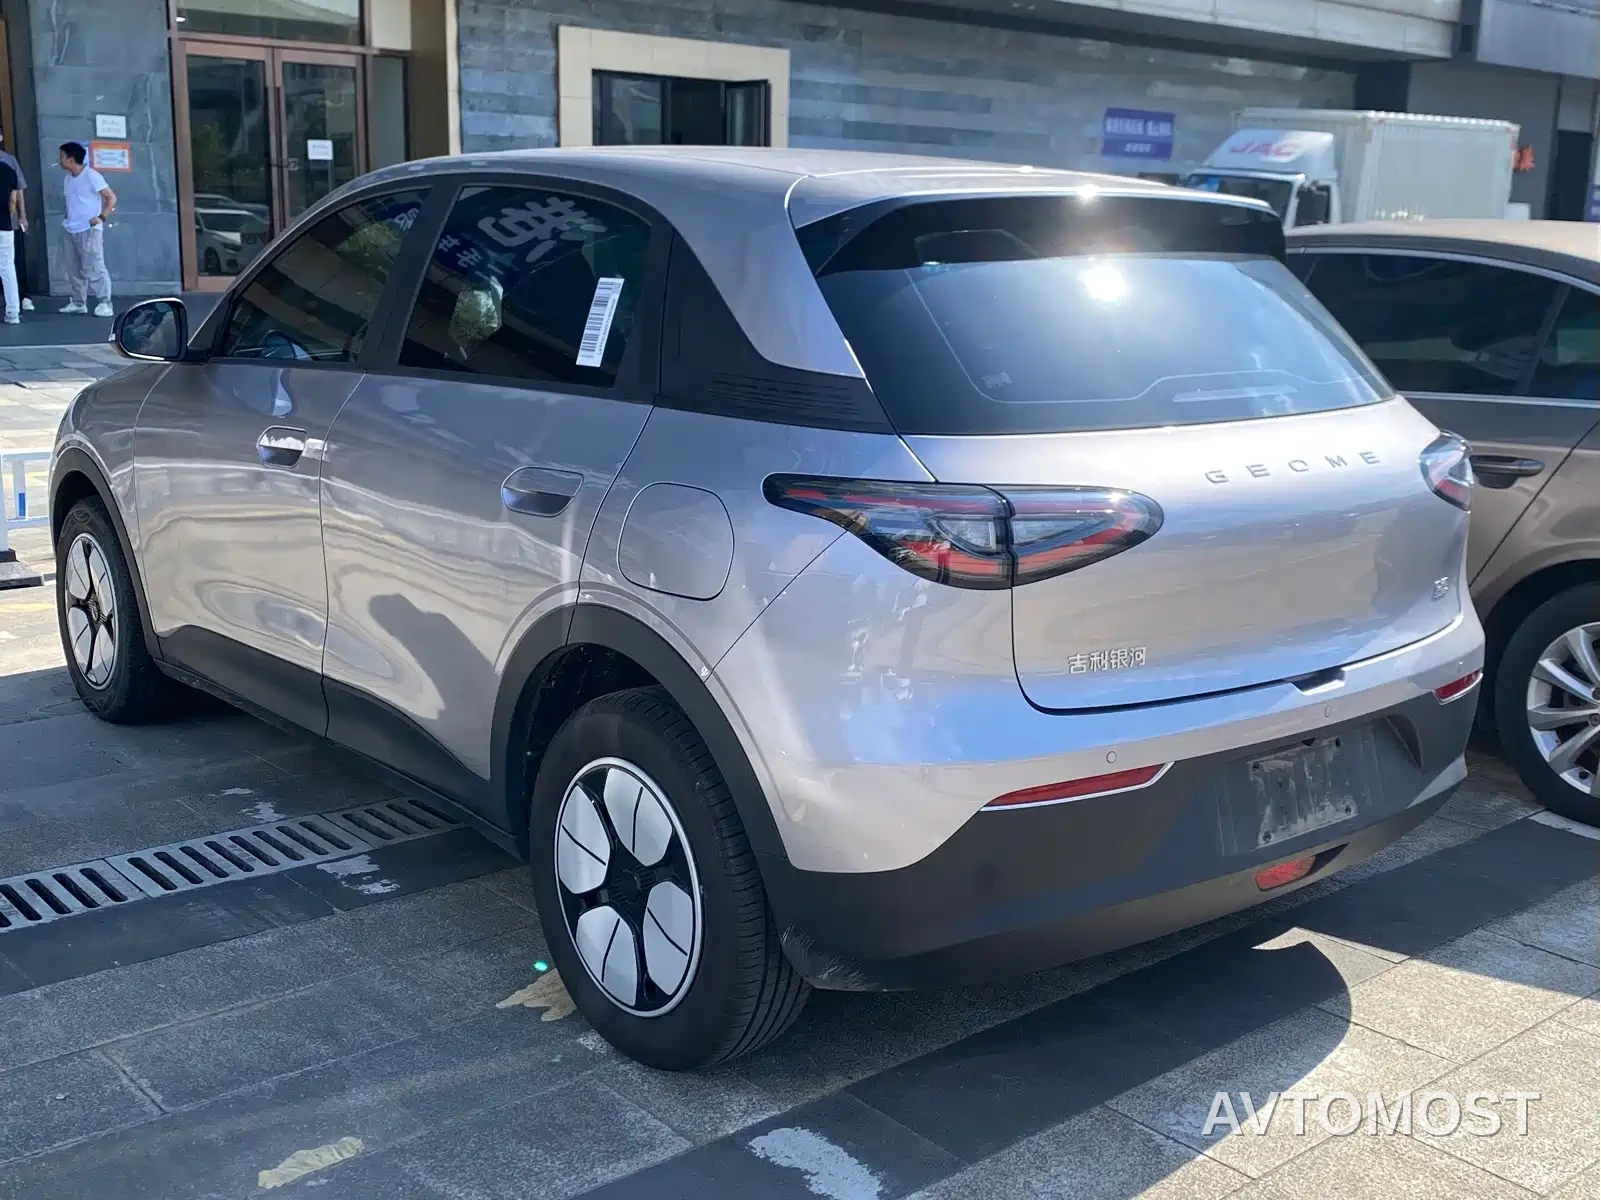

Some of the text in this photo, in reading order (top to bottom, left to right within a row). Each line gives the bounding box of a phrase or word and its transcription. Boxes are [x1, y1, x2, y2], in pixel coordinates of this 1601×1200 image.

[1230, 141, 1300, 157] JAC
[1205, 451, 1380, 484] GEOME
[1067, 645, 1147, 675] 吉利银河
